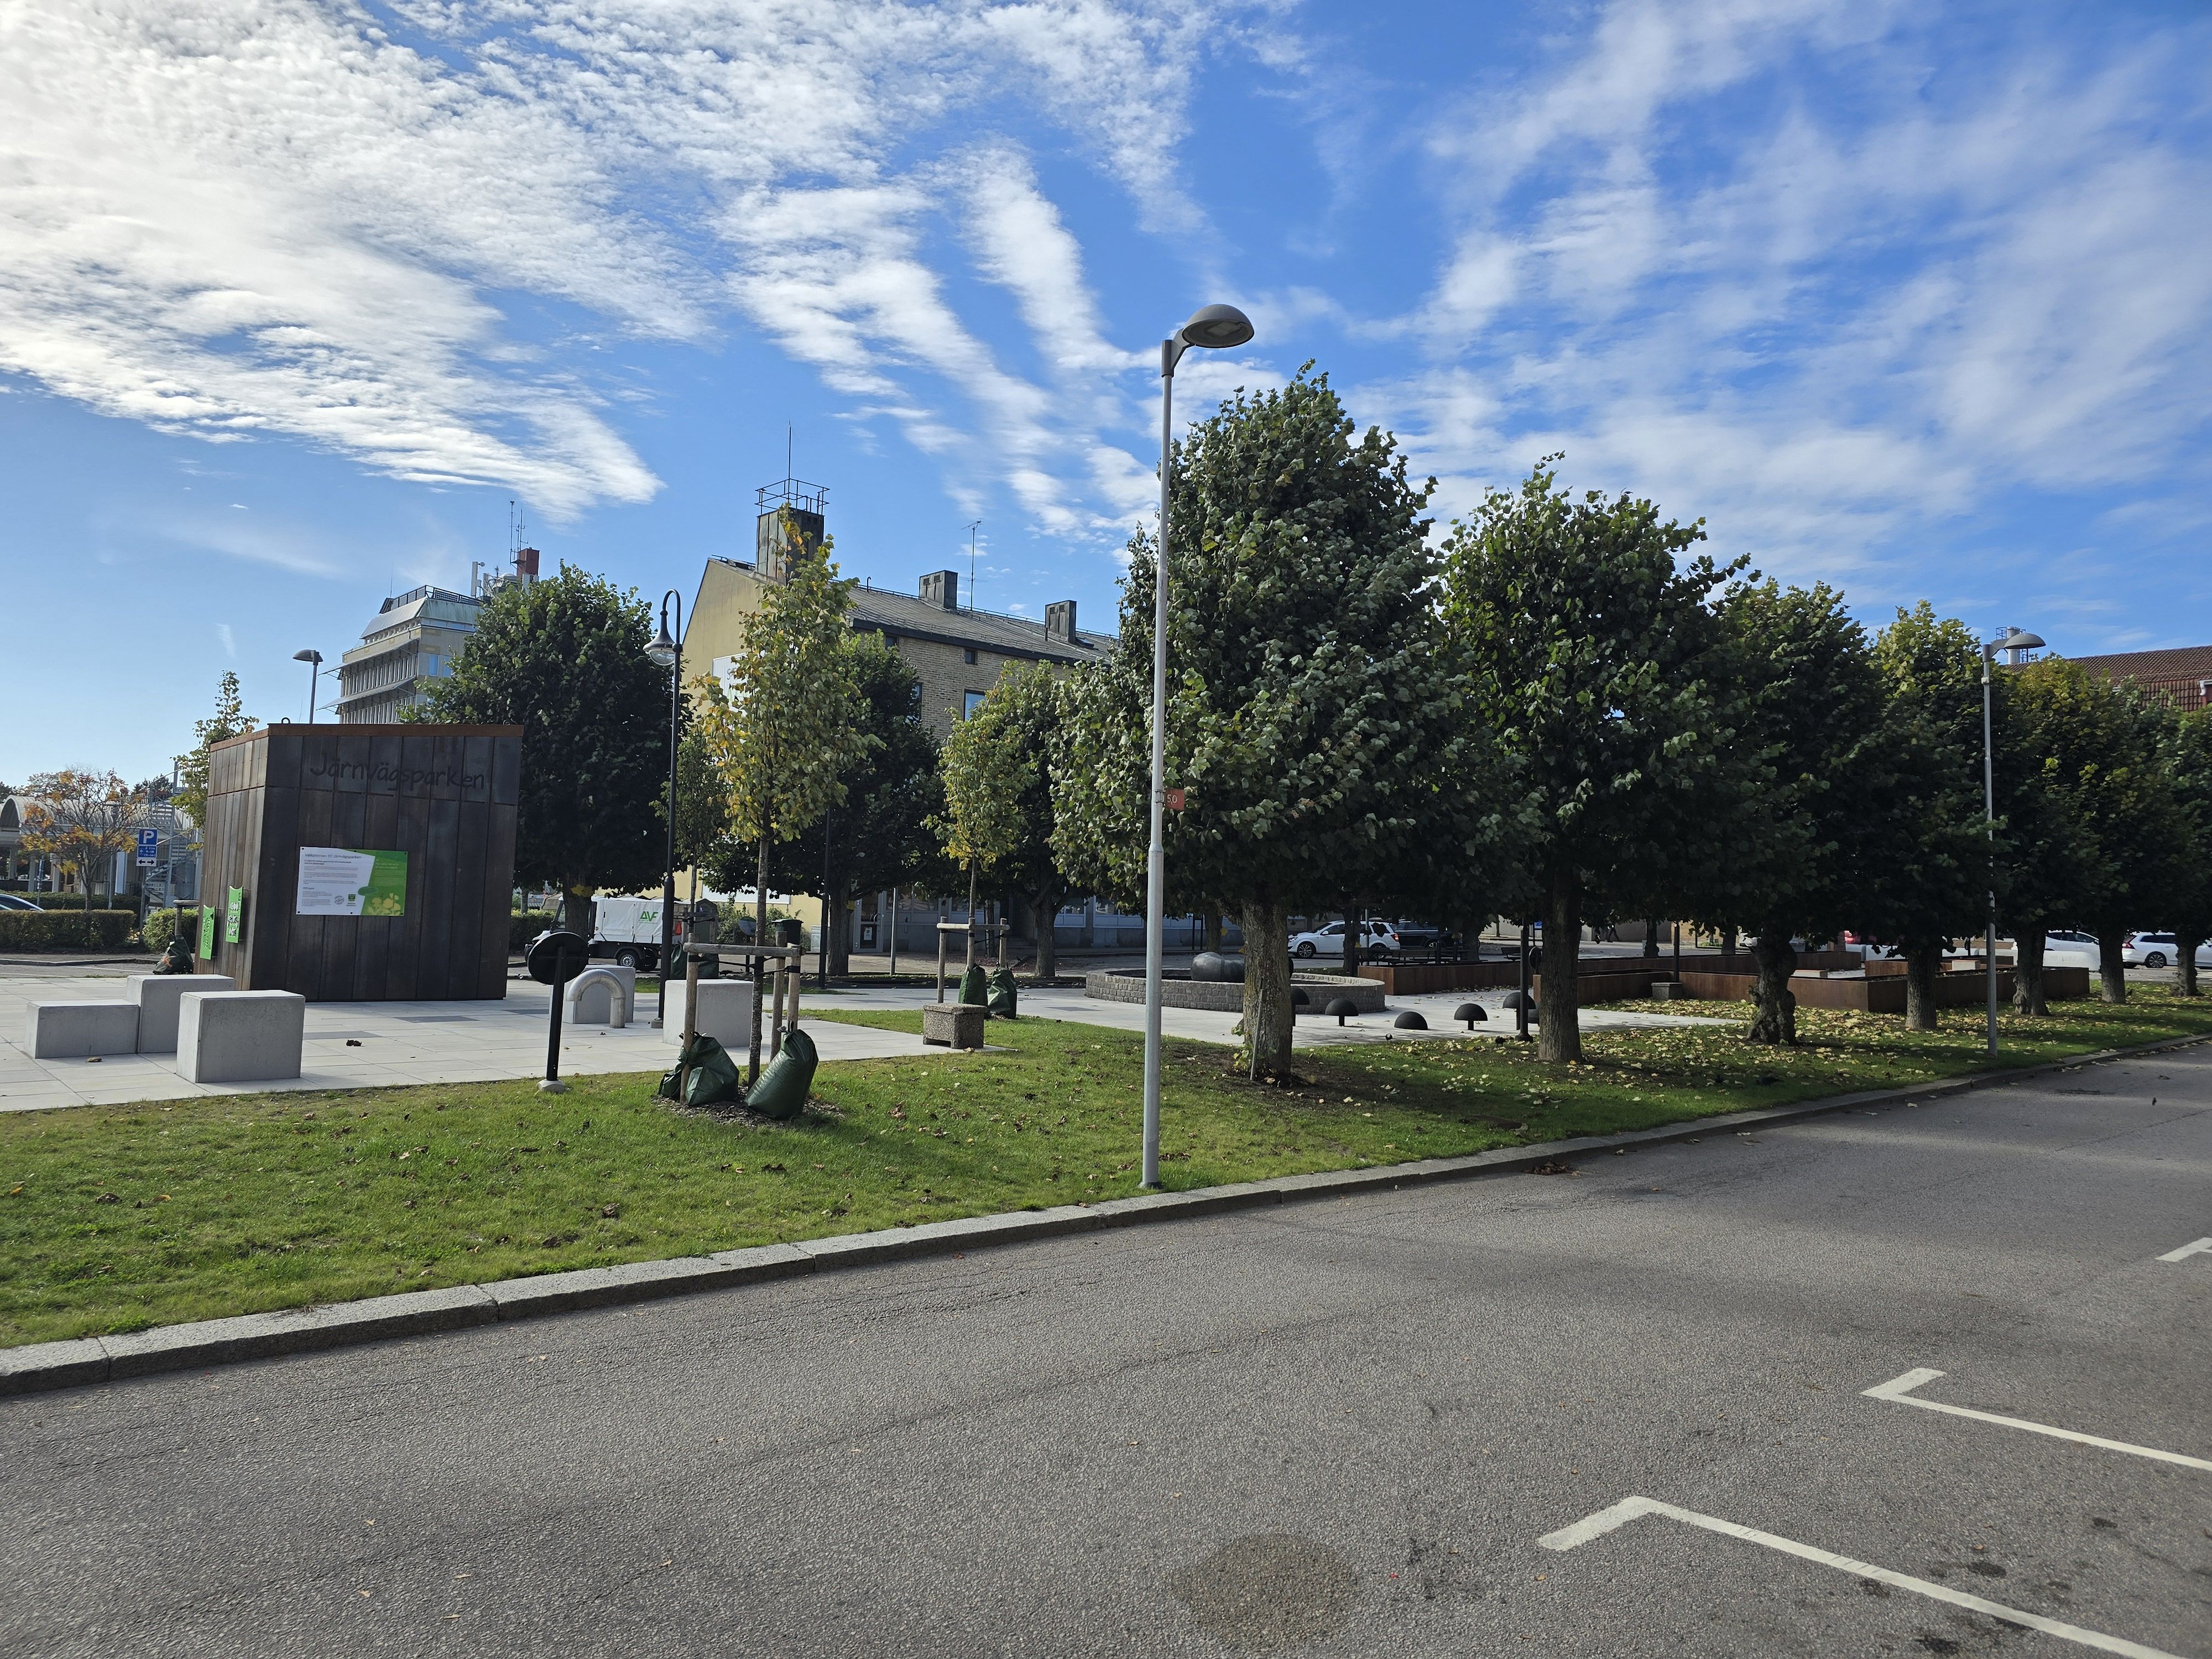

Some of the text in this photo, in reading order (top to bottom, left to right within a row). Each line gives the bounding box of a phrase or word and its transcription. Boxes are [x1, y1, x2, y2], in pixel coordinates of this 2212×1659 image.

[310, 753, 484, 791] Järnvägsparken
[1167, 794, 1177, 805] 5,0
[143, 831, 154, 843] P
[640, 911, 658, 921] AVF
